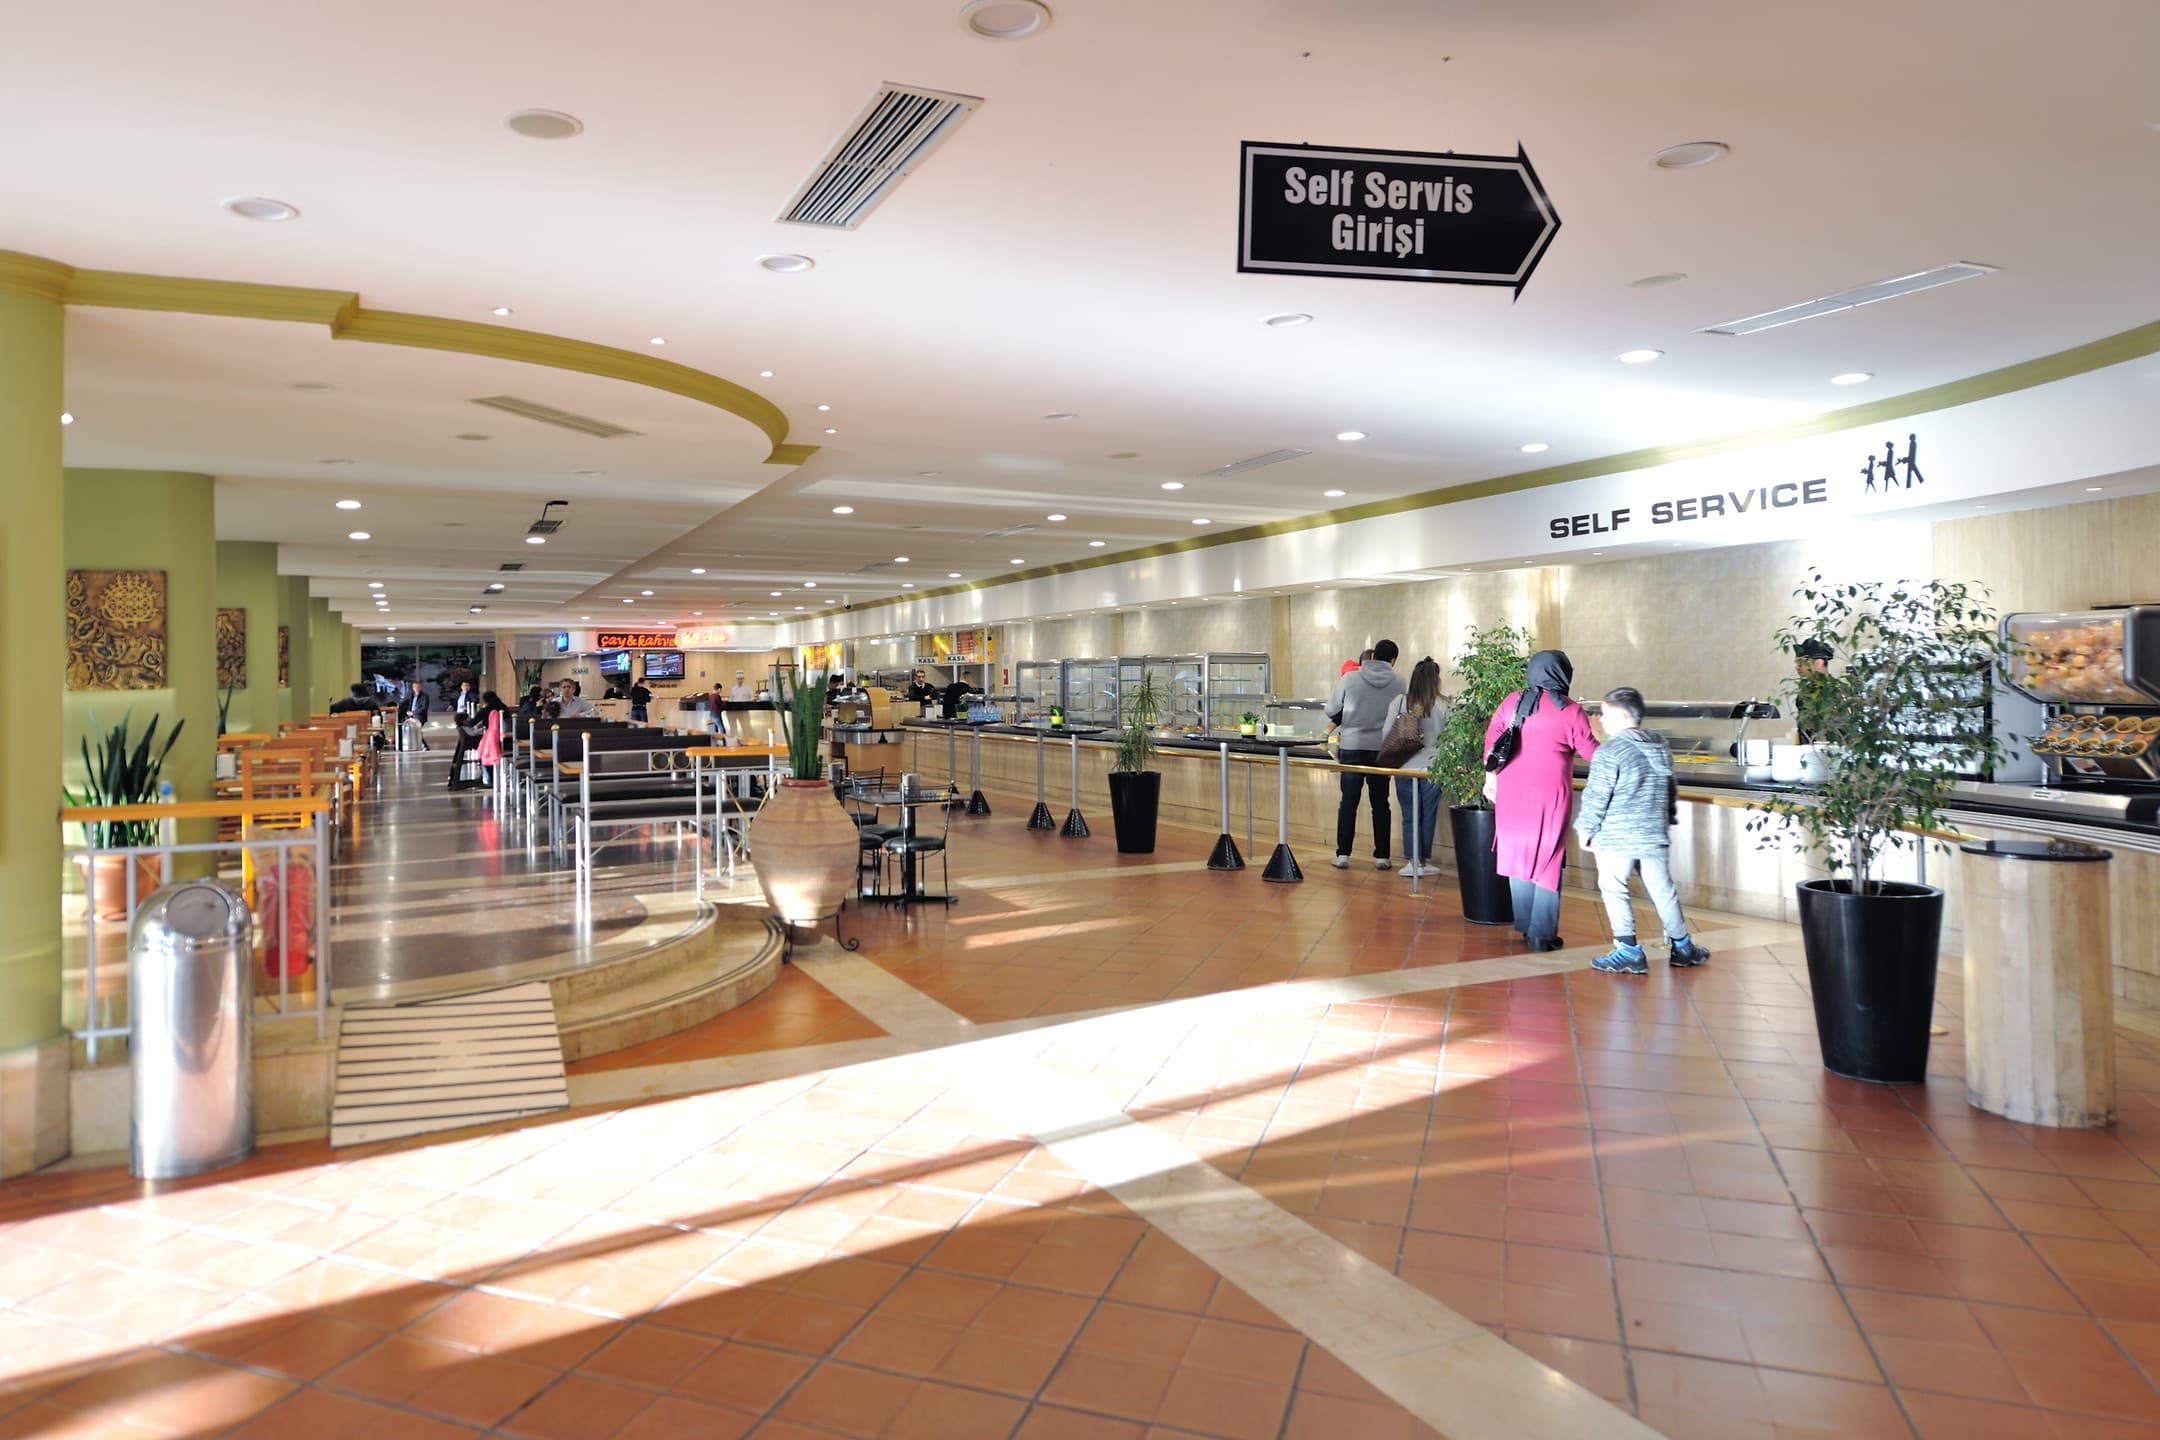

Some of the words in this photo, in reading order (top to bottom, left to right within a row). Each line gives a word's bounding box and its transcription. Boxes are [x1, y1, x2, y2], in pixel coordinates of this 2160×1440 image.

[1284, 166, 1354, 208] Self
[1364, 171, 1474, 214] Servis
[1331, 212, 1425, 259] Girişi
[1549, 508, 1631, 539] SELF
[1651, 477, 1828, 525] SERVICE
